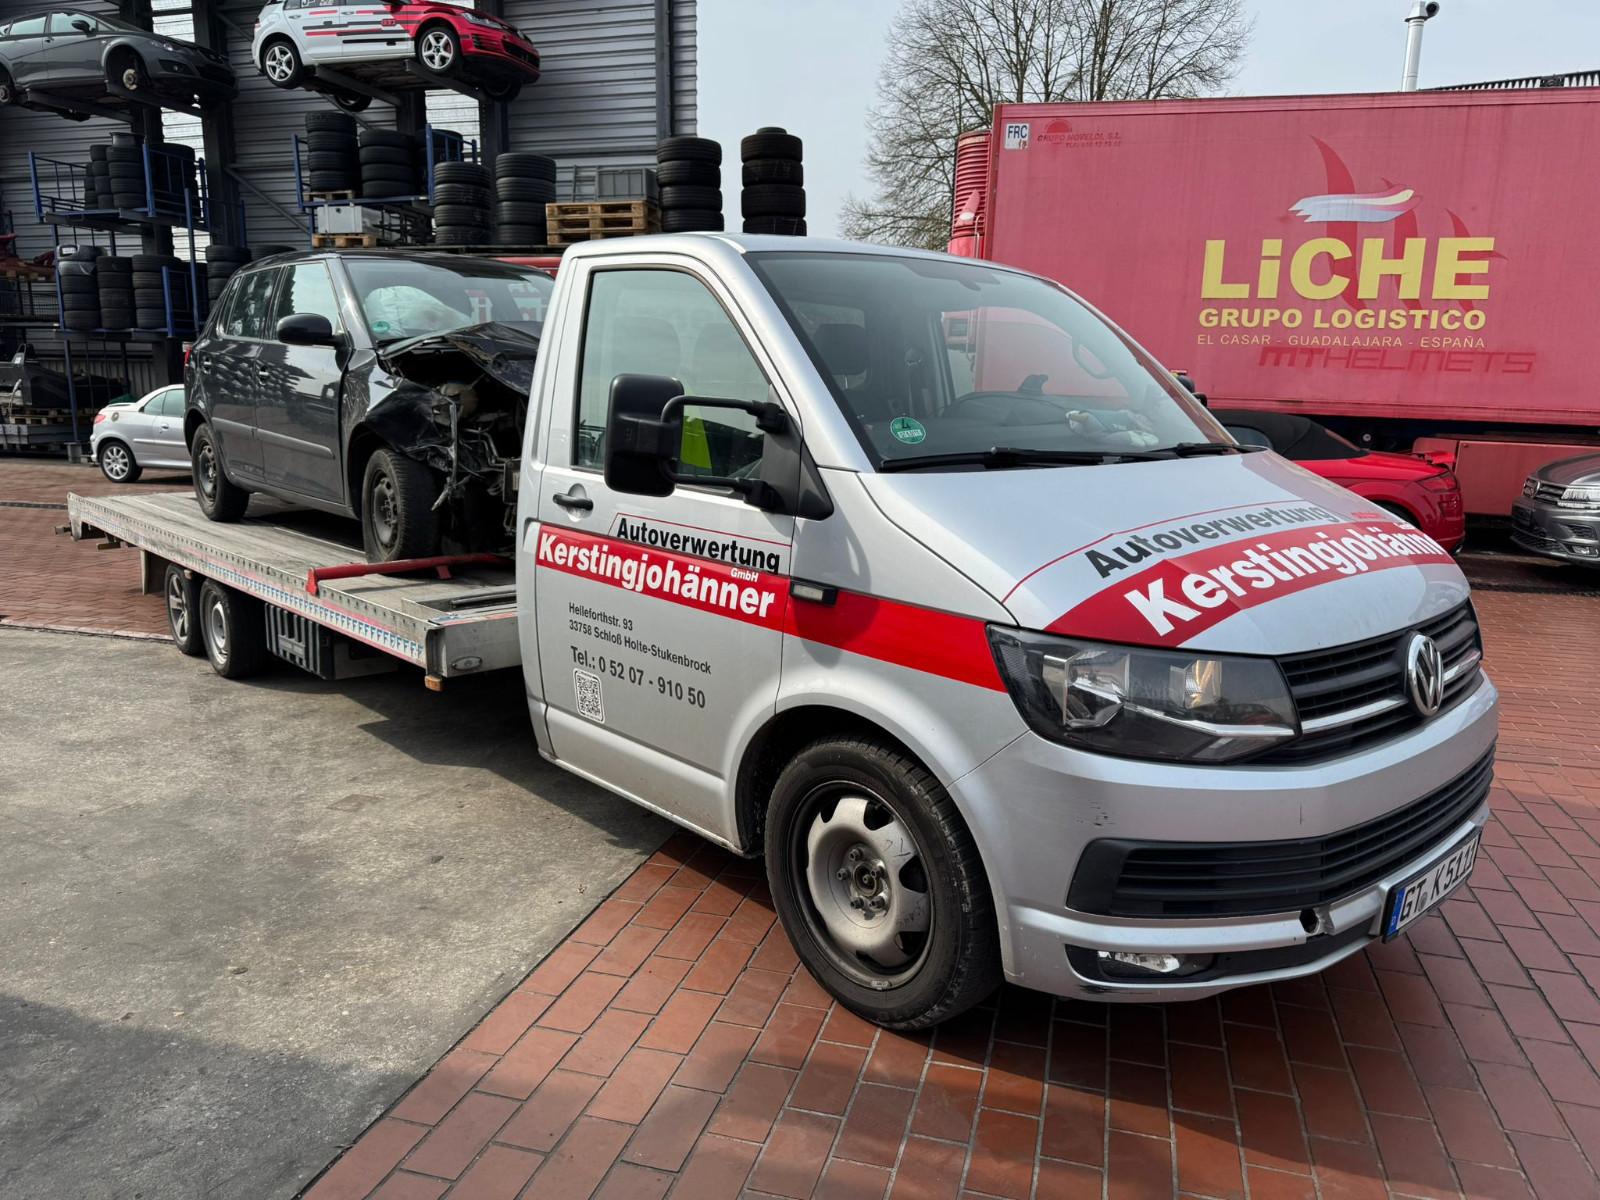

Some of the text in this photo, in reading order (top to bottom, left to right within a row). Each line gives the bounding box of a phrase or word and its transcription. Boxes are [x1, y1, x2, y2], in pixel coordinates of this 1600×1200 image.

[1008, 125, 1028, 139] FRC
[1197, 334, 1213, 345] EL
[1221, 334, 1271, 345] CASAR
[1288, 335, 1402, 347] GUADALAJARA
[1420, 335, 1486, 348] ESPAÑA
[1199, 308, 1487, 331] GRUPO LOGISTICO
[617, 518, 780, 575] Autoverwertung
[1084, 504, 1338, 579] Autoverwertung
[538, 533, 776, 618] Kerstingjohänner
[730, 567, 759, 582] GmbH
[569, 602, 633, 631] Helleforthstr. 93
[569, 620, 712, 675] 33758 Schloß Holte-Stukenbrock
[570, 645, 595, 670] Tel.:
[599, 656, 606, 673] 0
[610, 660, 625, 680] 52
[629, 667, 644, 686] 07
[658, 677, 683, 701] 910
[688, 687, 706, 709] 50
[1400, 878, 1427, 921] GT
[1431, 864, 1446, 901] K
